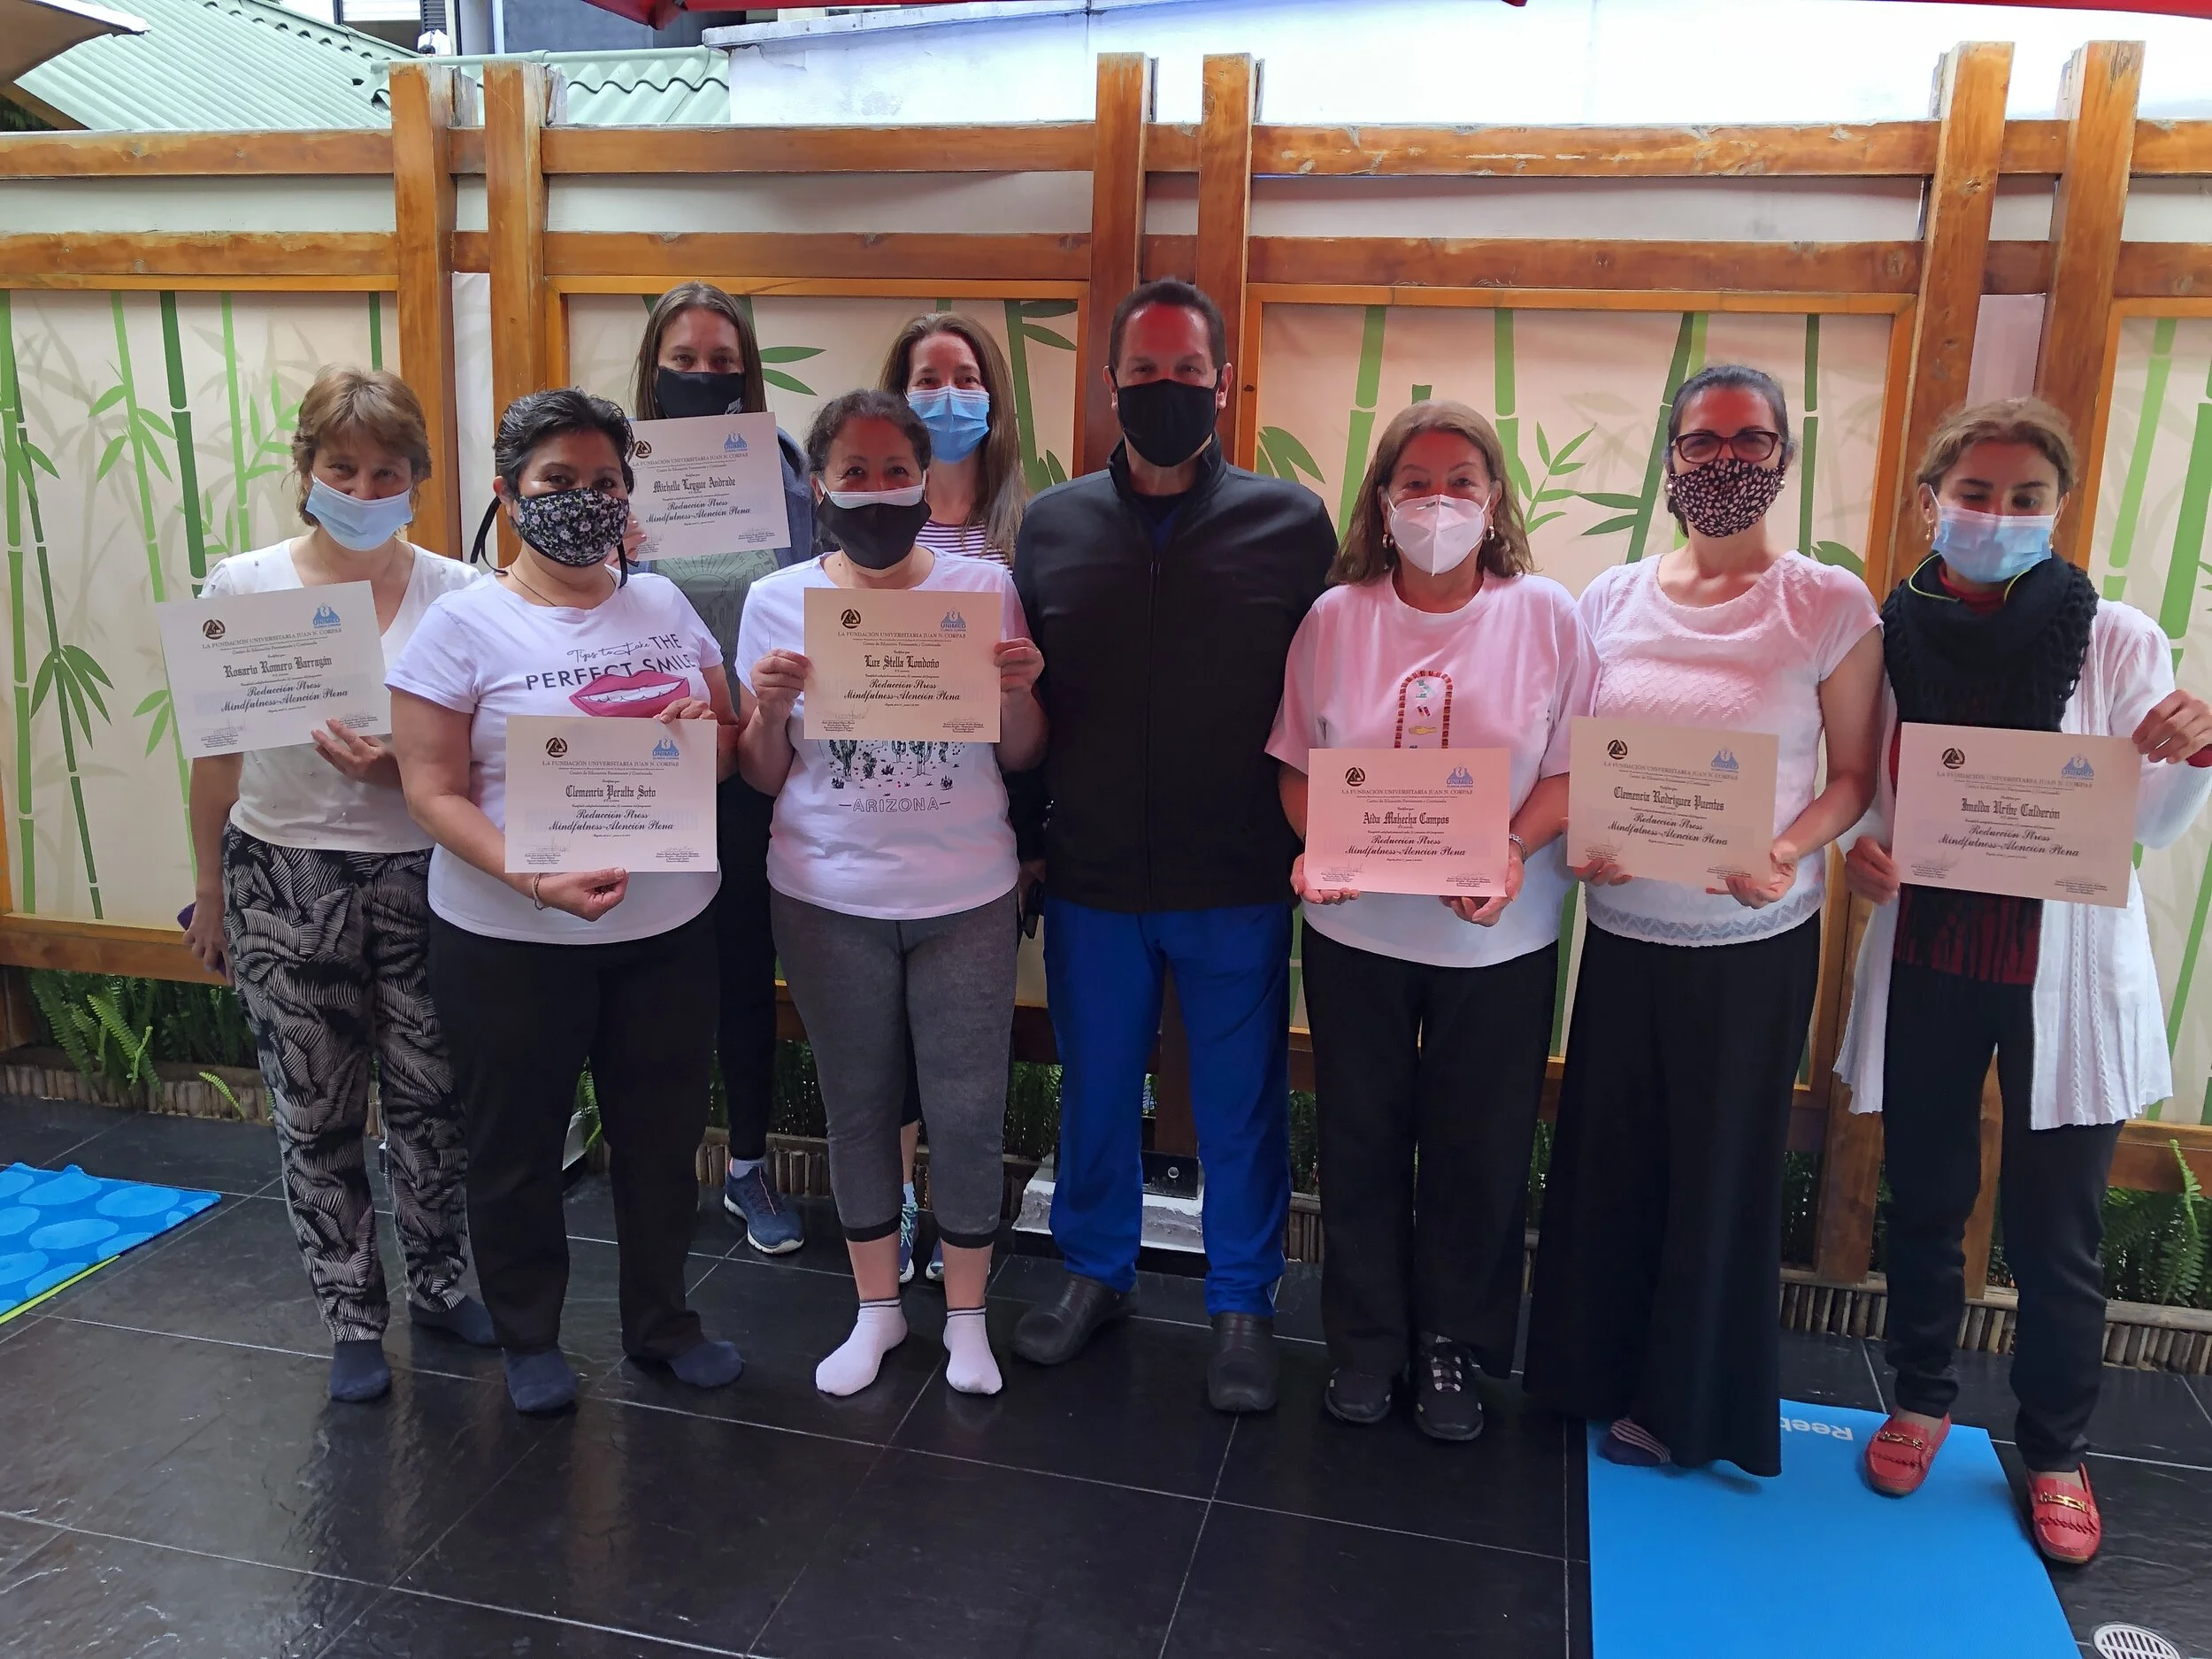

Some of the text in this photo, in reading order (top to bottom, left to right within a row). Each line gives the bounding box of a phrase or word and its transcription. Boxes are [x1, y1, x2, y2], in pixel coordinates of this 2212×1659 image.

[707, 474, 736, 488] Andrade
[707, 497, 727, 506] Stress
[727, 504, 750, 515] Plena
[248, 633, 296, 643] UNIVERSITARIA
[566, 649, 598, 664] Tips
[649, 634, 681, 649] THE
[864, 655, 939, 670] Luz Stella Londoño
[526, 663, 634, 690] PERFECT
[642, 654, 696, 672] SMILE
[246, 683, 293, 696] Reducción
[295, 680, 320, 690] Stress
[913, 679, 936, 689] Stress
[320, 686, 348, 699] Plena
[935, 690, 960, 700] Plena
[565, 784, 656, 800] Clemencia Peralta Soto
[853, 797, 940, 812] ARIZONA
[1613, 786, 1650, 803] Clemencia
[1694, 795, 1724, 812] Puentes
[575, 809, 649, 818] Reducción Stress
[1363, 811, 1449, 826] Aida Mahecha Campos
[647, 819, 673, 830] Plena
[1678, 818, 1702, 830] Stress
[1417, 834, 1441, 844] Stress
[1701, 832, 1728, 845] Plena
[2023, 829, 2052, 841] Stress
[1440, 846, 1466, 856] Plena
[2049, 842, 2081, 856] Plena
